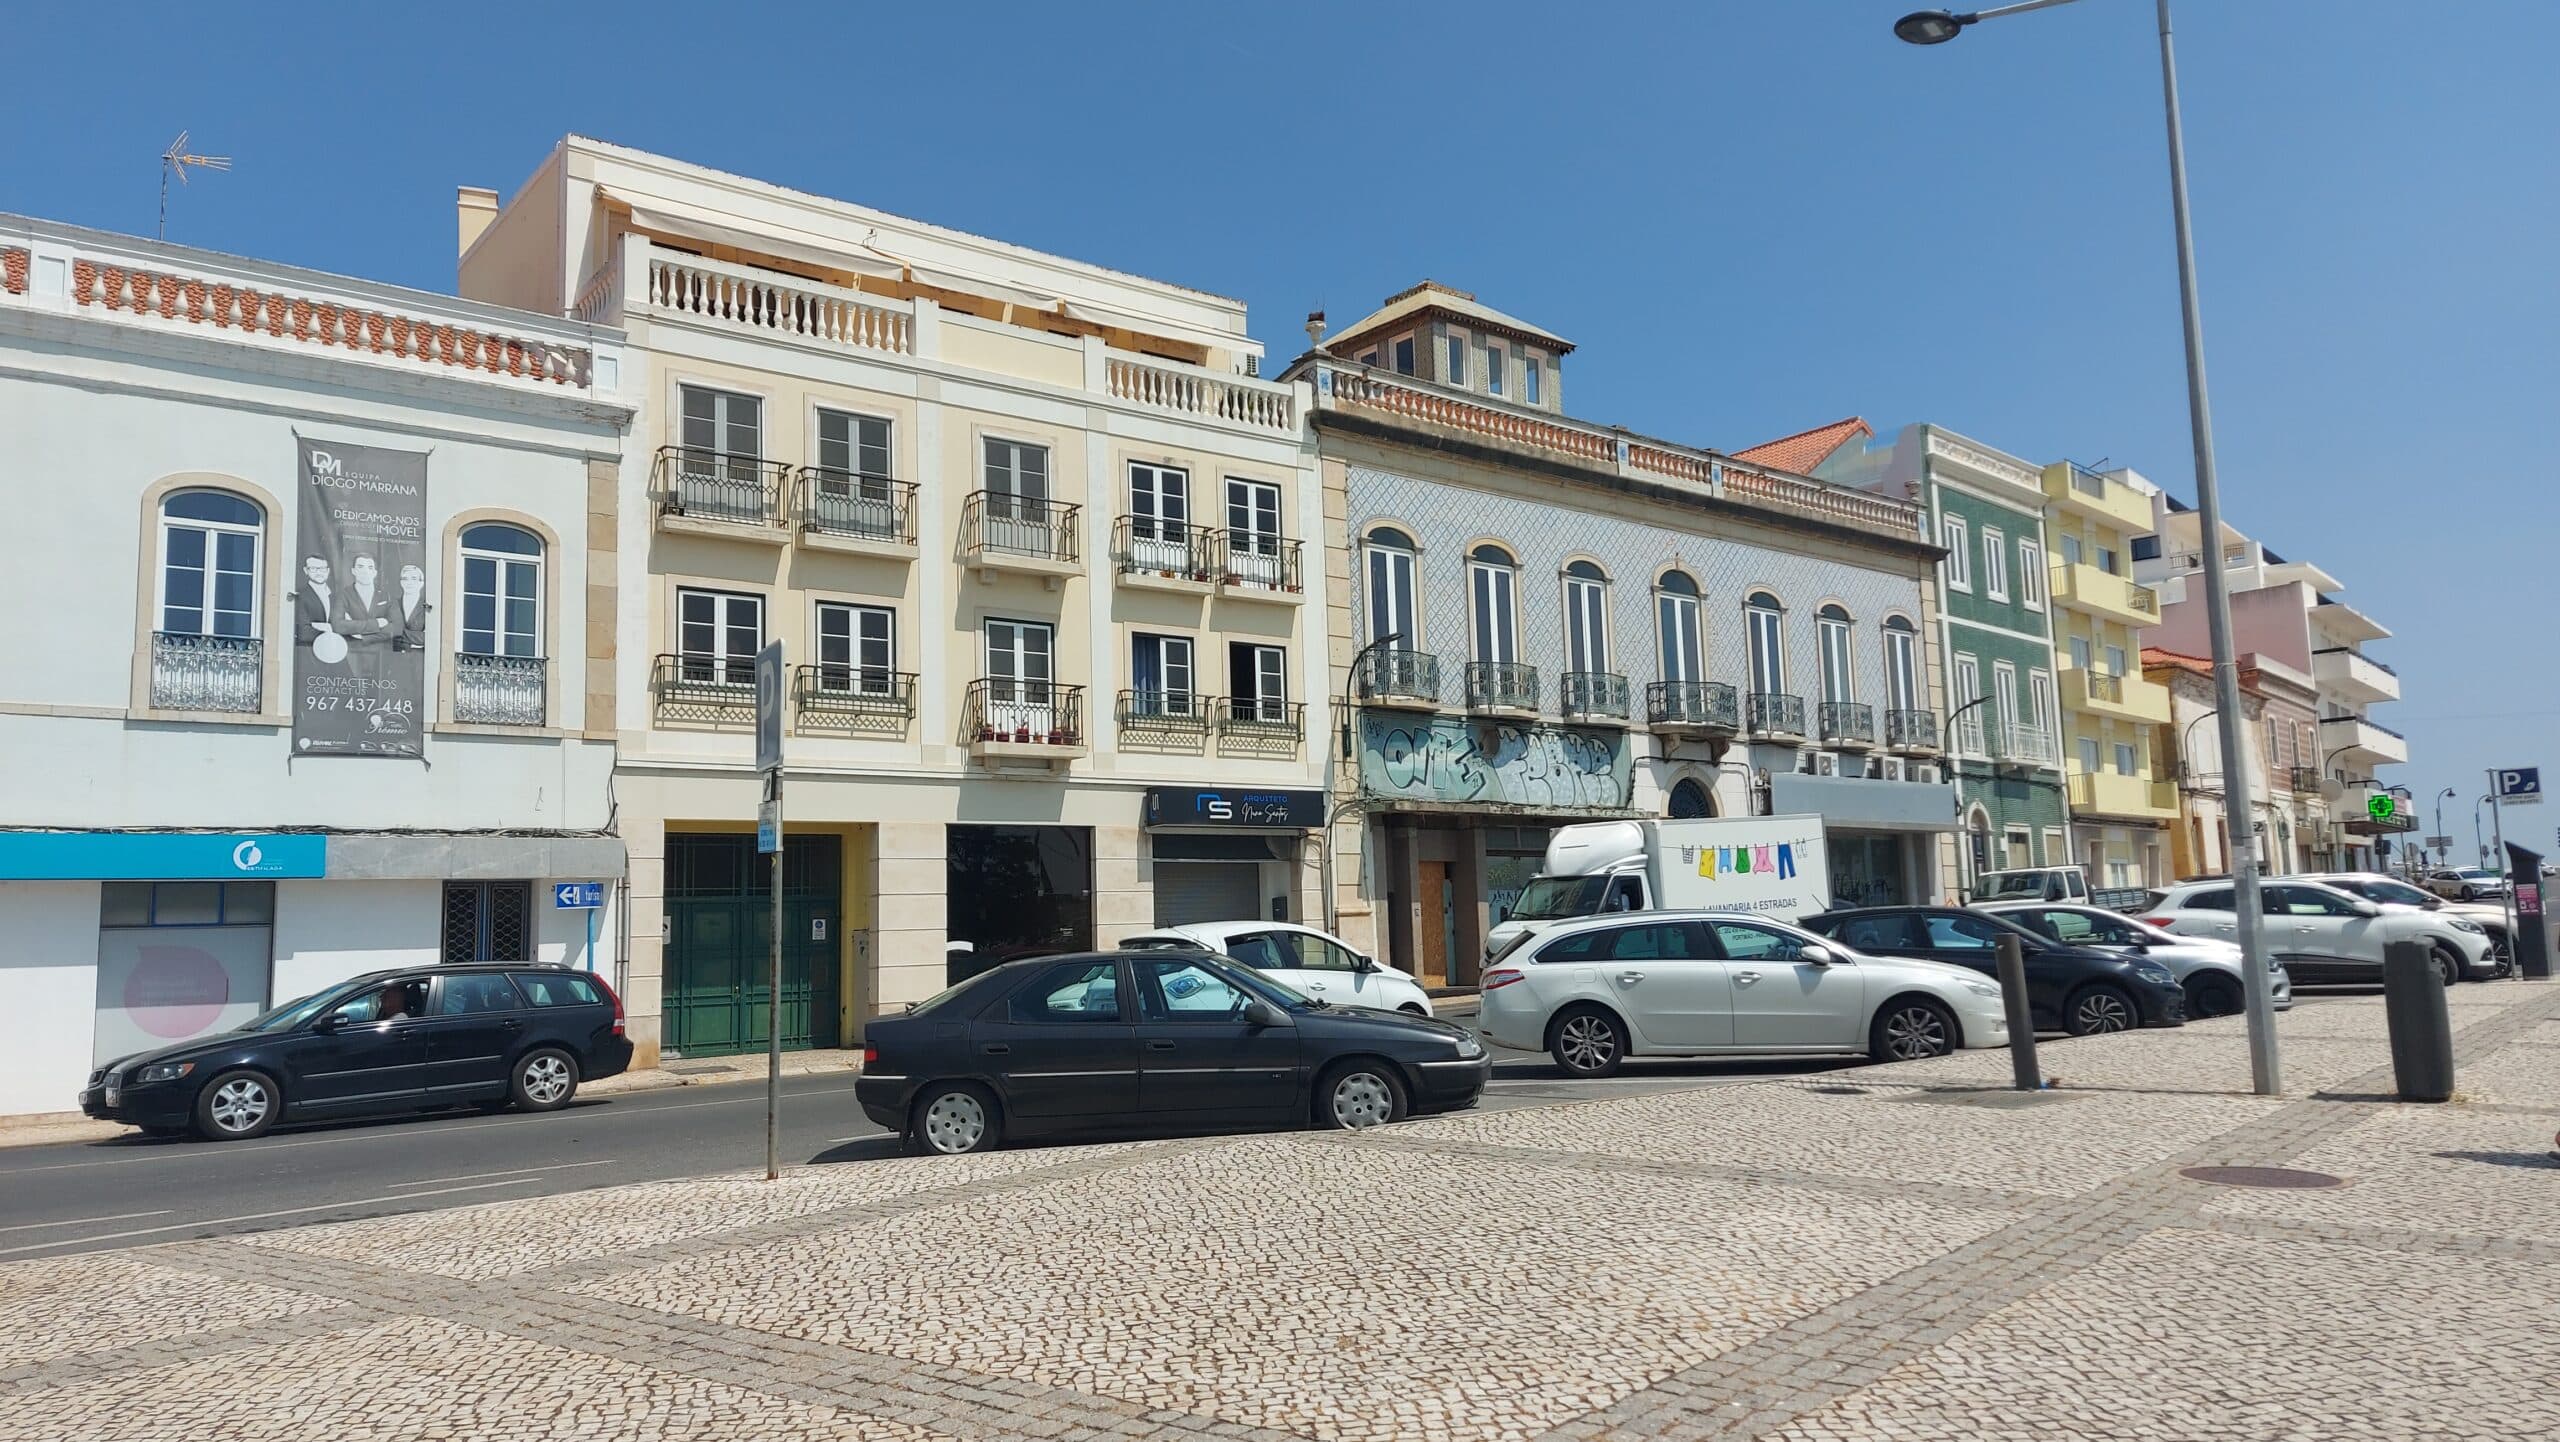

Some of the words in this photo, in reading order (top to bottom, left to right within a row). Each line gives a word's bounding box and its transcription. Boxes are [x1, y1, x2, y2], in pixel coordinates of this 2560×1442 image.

[311, 474, 356, 490] DIOGO
[359, 480, 418, 497] MARRANA
[334, 509, 420, 527] DEDICAMO-NOS
[376, 523, 420, 538] IMÓVEL
[306, 675, 398, 690] CONTACTE-NOS
[306, 686, 352, 695] CONTACT
[306, 696, 339, 711] 967
[344, 697, 376, 712] 437
[381, 698, 413, 714] 448
[761, 659, 775, 755] P
[2502, 772, 2521, 793] P
[1243, 794, 1288, 803] ARQUITETO
[1752, 901, 1758, 910] 4
[1759, 898, 1798, 911] ESTRADAS
